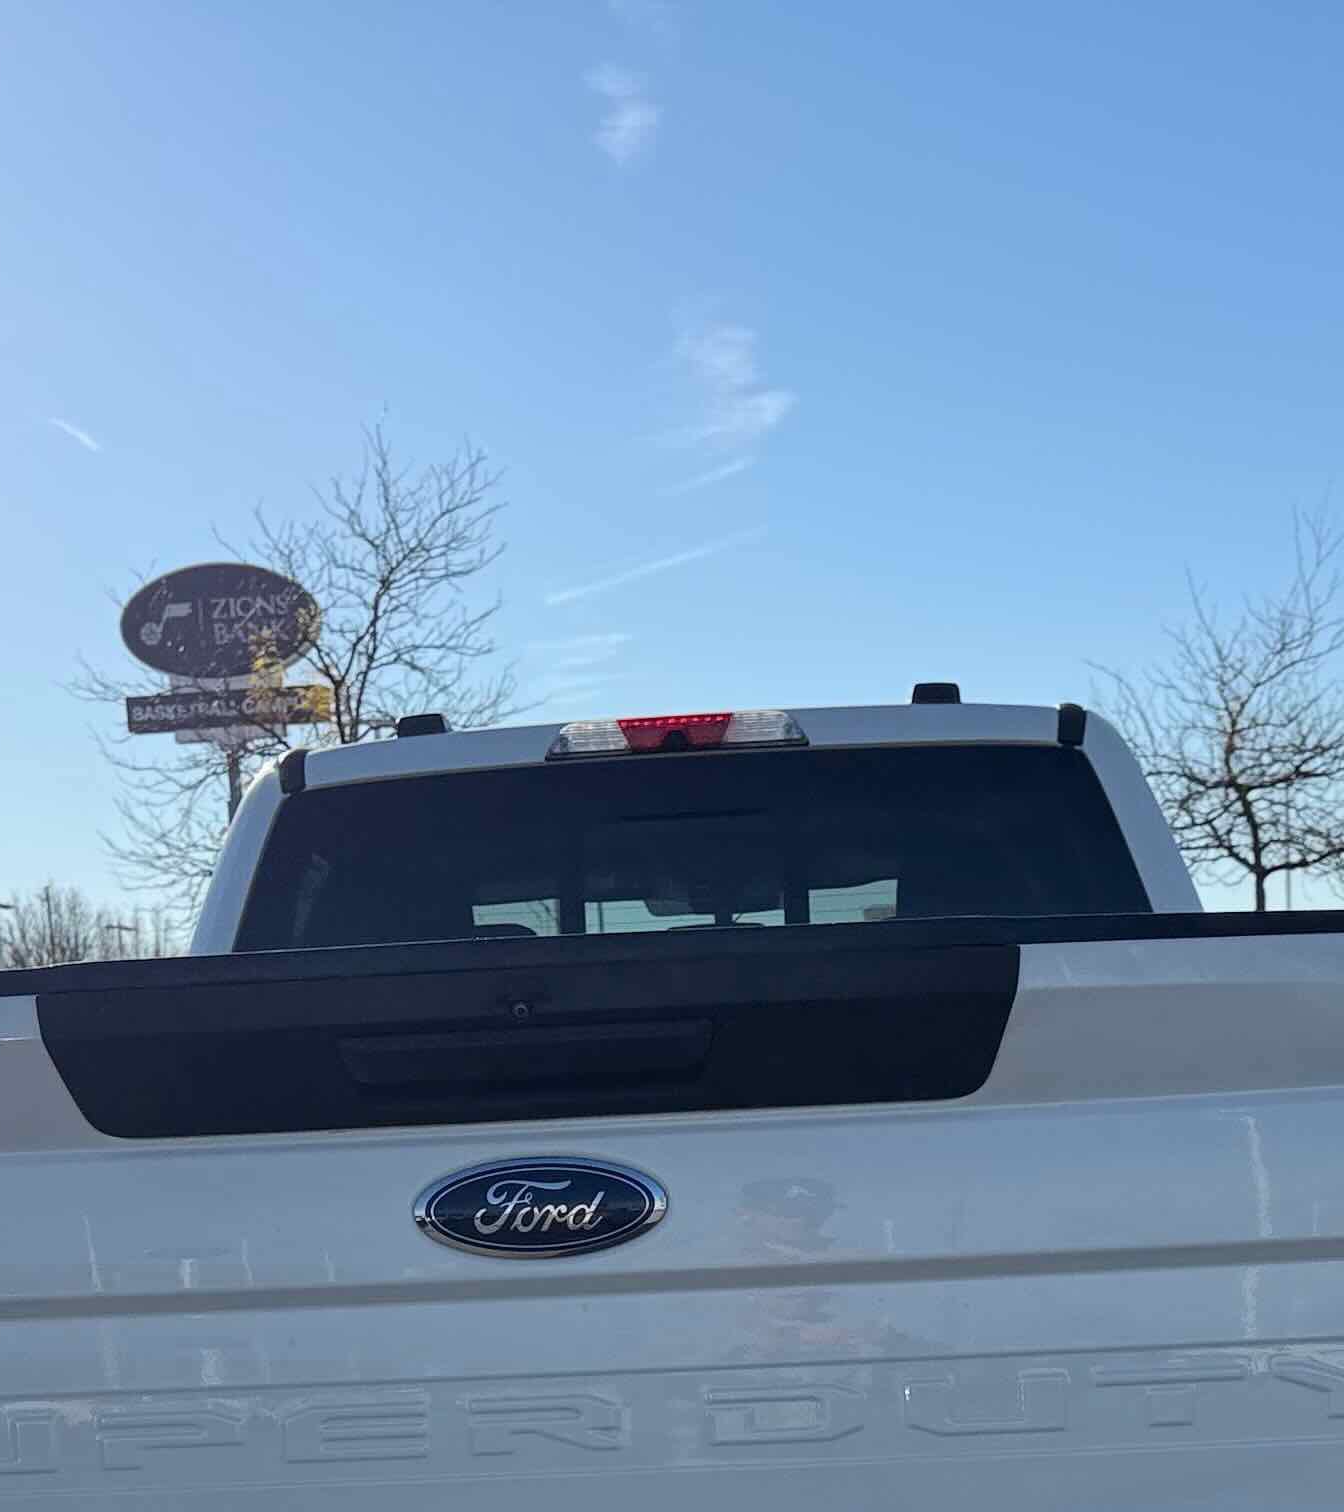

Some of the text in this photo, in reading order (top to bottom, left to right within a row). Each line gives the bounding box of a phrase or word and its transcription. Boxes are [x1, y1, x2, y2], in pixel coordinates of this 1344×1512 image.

[210, 597, 289, 618] ZIONS
[214, 620, 290, 645] BAK
[474, 1180, 605, 1234] Ford
